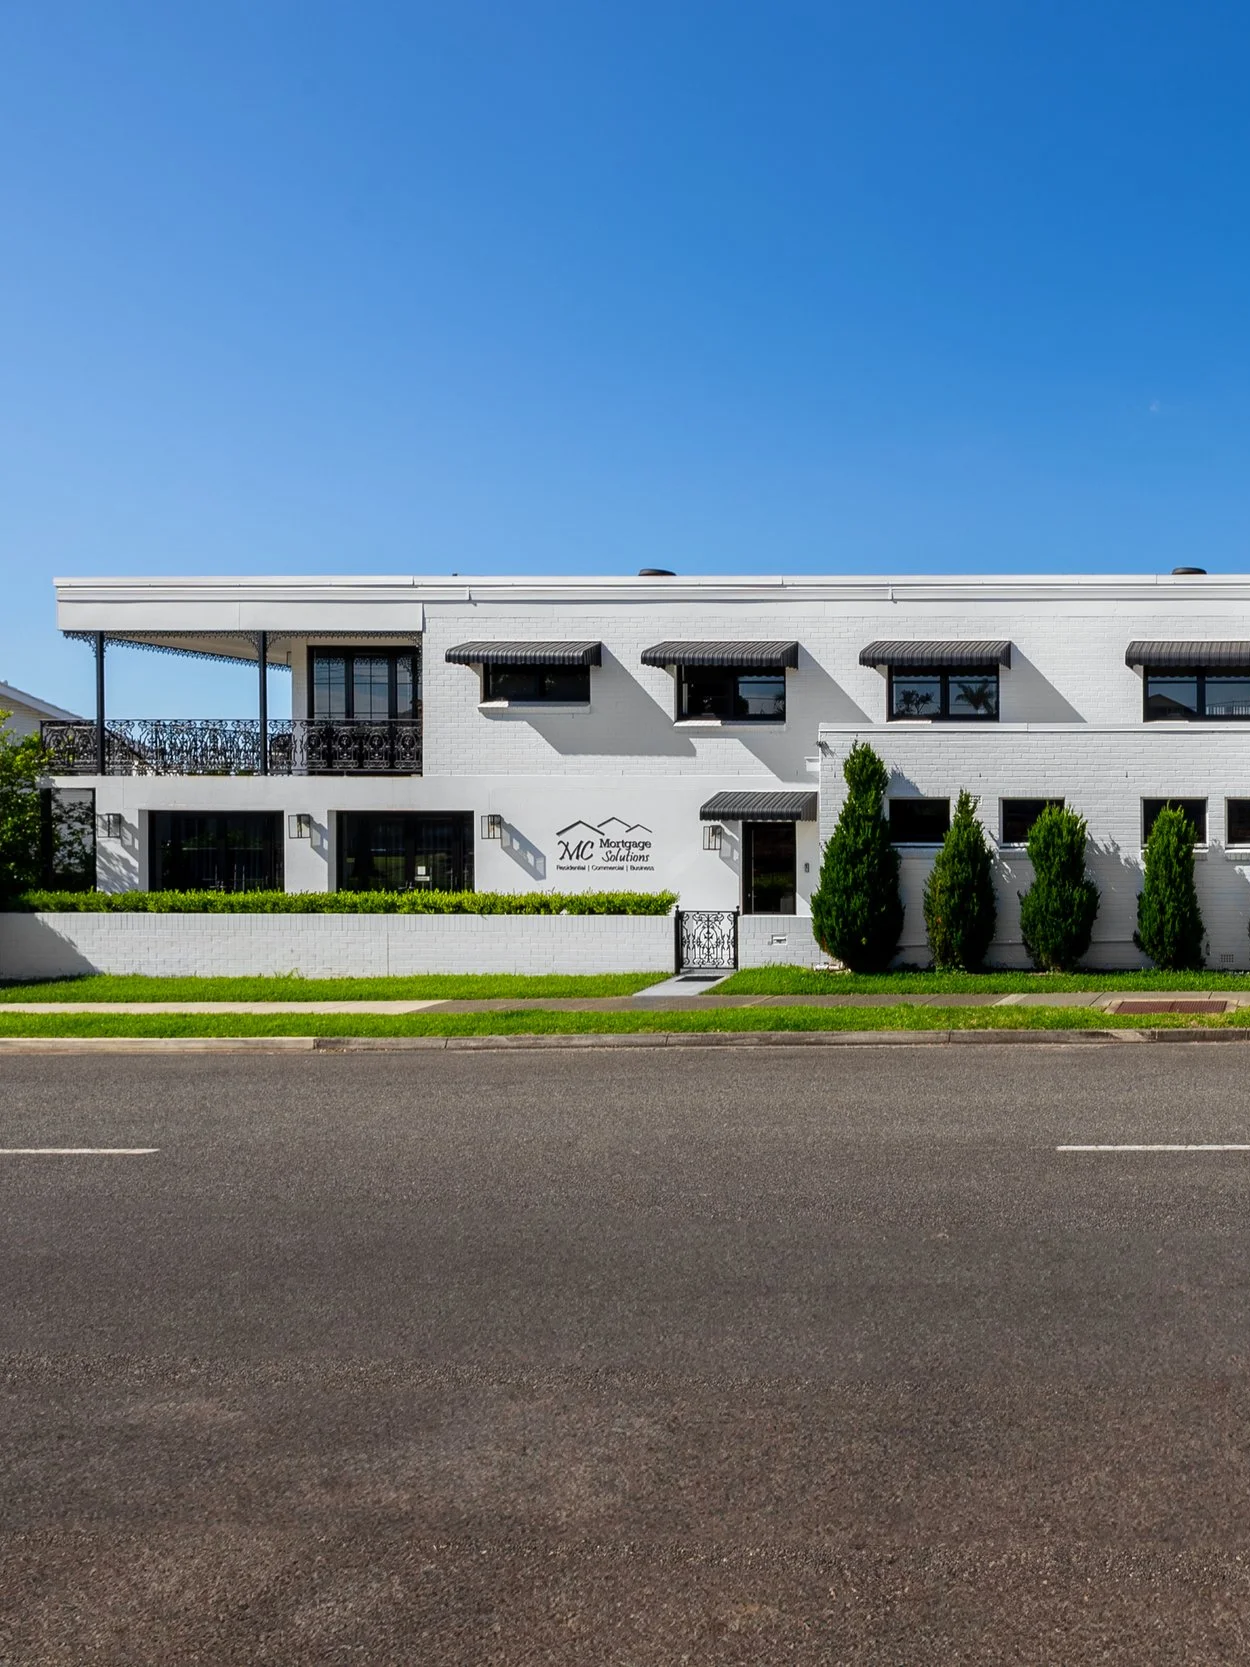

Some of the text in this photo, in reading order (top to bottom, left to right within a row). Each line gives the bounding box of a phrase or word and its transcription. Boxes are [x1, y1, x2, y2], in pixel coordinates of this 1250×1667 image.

[557, 840, 595, 861] MC
[599, 838, 652, 851] Mortgage
[601, 848, 650, 862] Solutions
